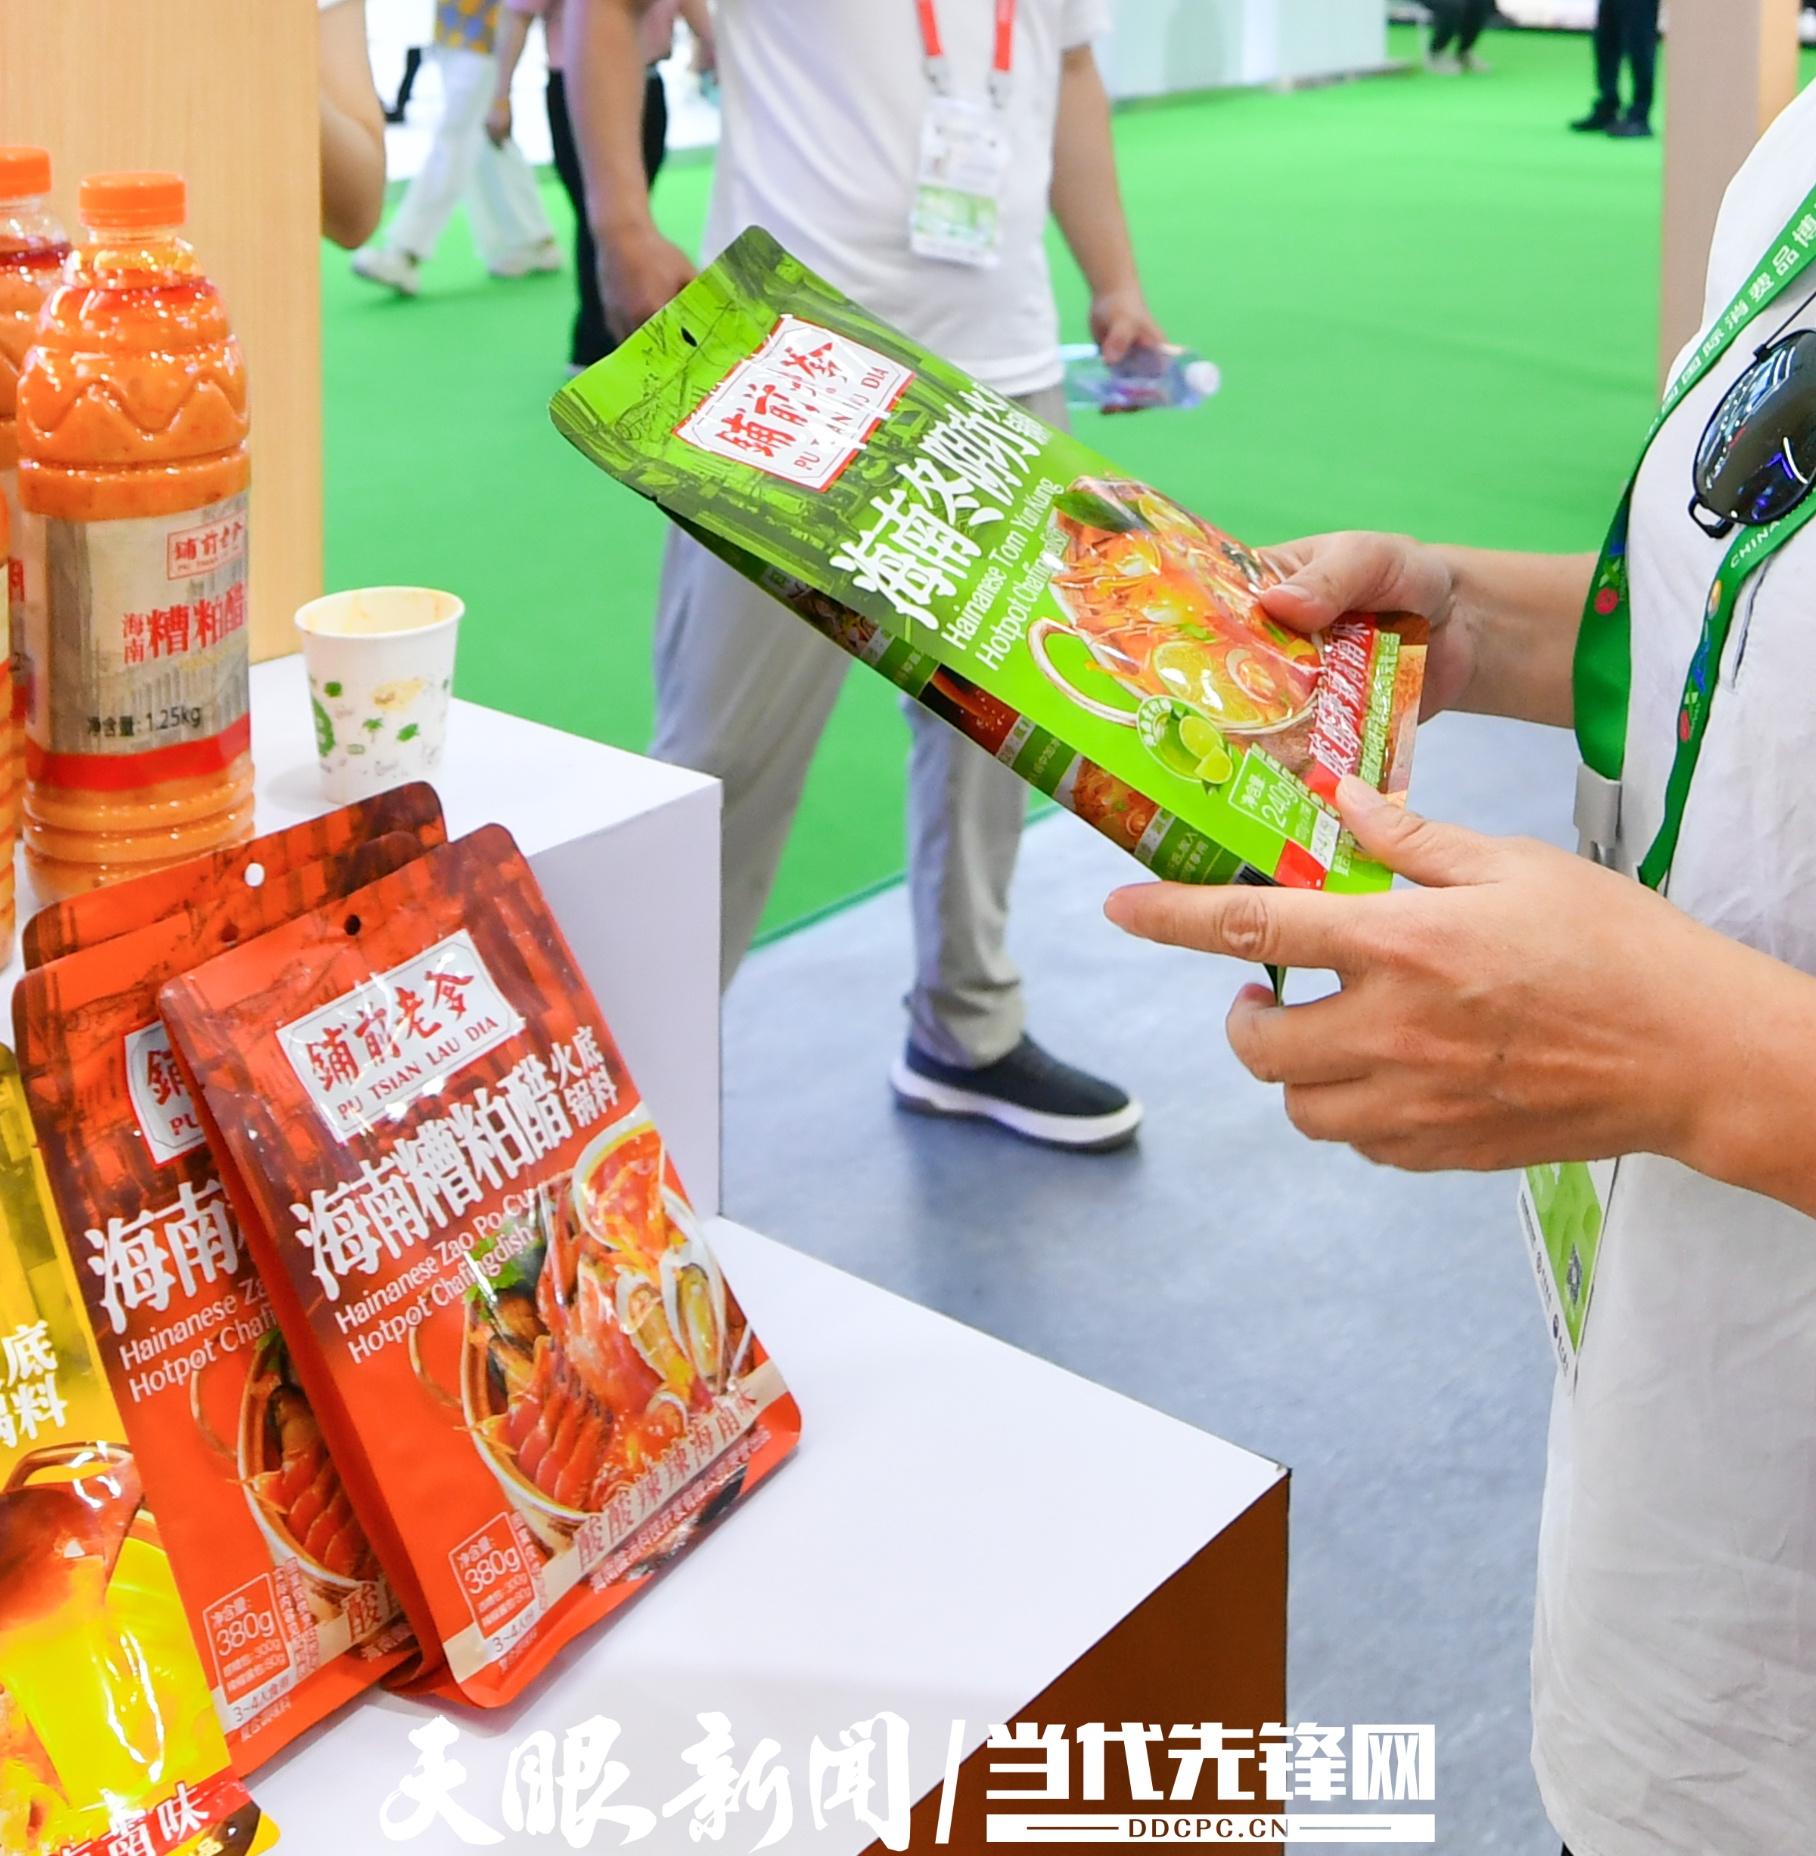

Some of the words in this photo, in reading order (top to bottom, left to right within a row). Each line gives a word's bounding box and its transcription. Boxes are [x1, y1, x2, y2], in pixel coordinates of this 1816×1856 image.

[860, 365, 891, 393] DIA
[829, 398, 1044, 632] 海南冬阴功
[940, 560, 1010, 653] Hainanese
[989, 527, 1024, 569] Tom
[974, 590, 1031, 672] Hotpot
[145, 706, 203, 731] 1.25kg
[1261, 779, 1300, 829] 240g
[336, 1093, 363, 1122] PU
[367, 1060, 423, 1102] TSIAN
[426, 1037, 463, 1069] LAU
[465, 1014, 501, 1044] DIA
[289, 1054, 575, 1304] 海南糟粕醋
[333, 1251, 441, 1335] Hainanese
[432, 1227, 476, 1269] Zao
[471, 1206, 504, 1239] Po
[119, 1292, 237, 1372] Hainanese
[345, 1293, 434, 1366] Hotpot
[127, 1339, 218, 1404] Hotpot
[463, 1546, 522, 1595] 380g
[216, 1609, 276, 1657] 380g
